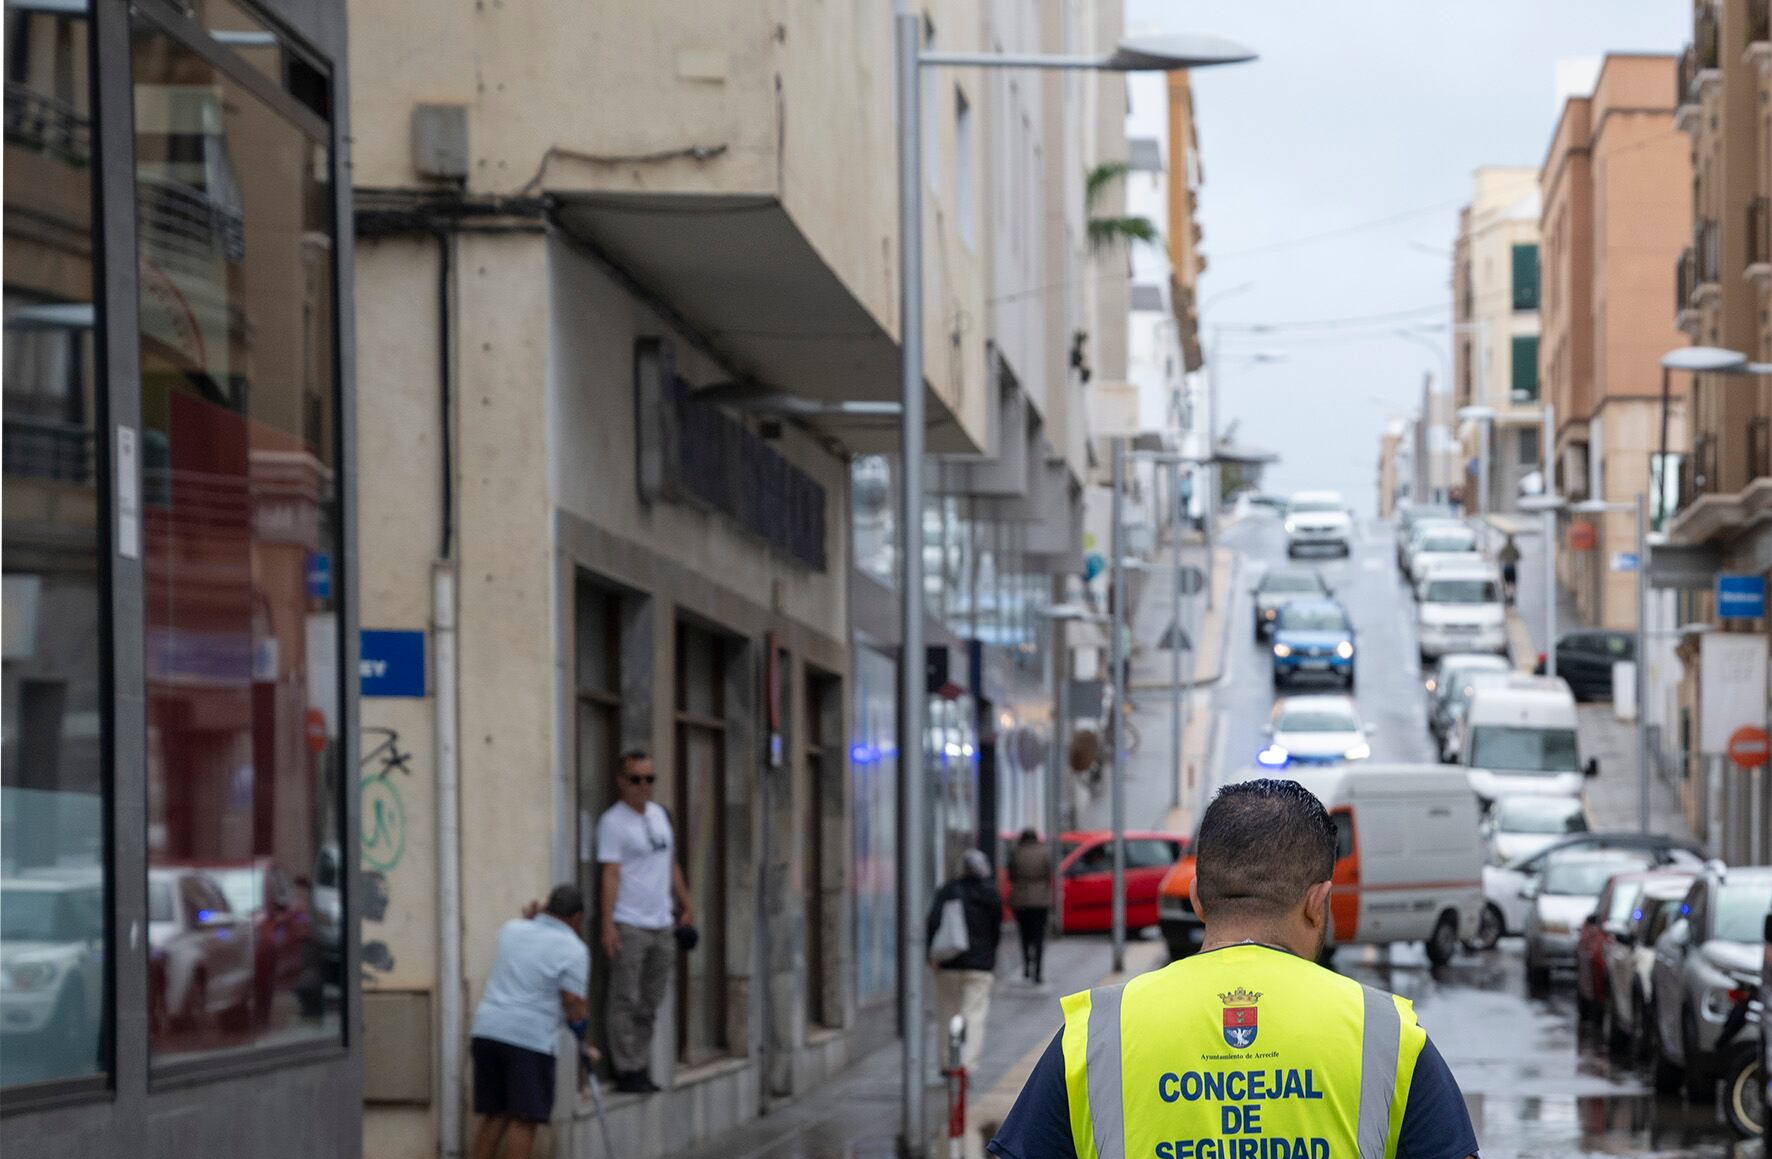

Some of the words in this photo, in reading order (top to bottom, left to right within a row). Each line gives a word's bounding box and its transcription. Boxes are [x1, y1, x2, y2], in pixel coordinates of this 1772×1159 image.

[1201, 1053, 1244, 1061] Ayuntamiento
[1255, 1051, 1279, 1059] Arrecife
[1158, 1069, 1323, 1103] CONCEJAL
[1221, 1104, 1262, 1135] DE
